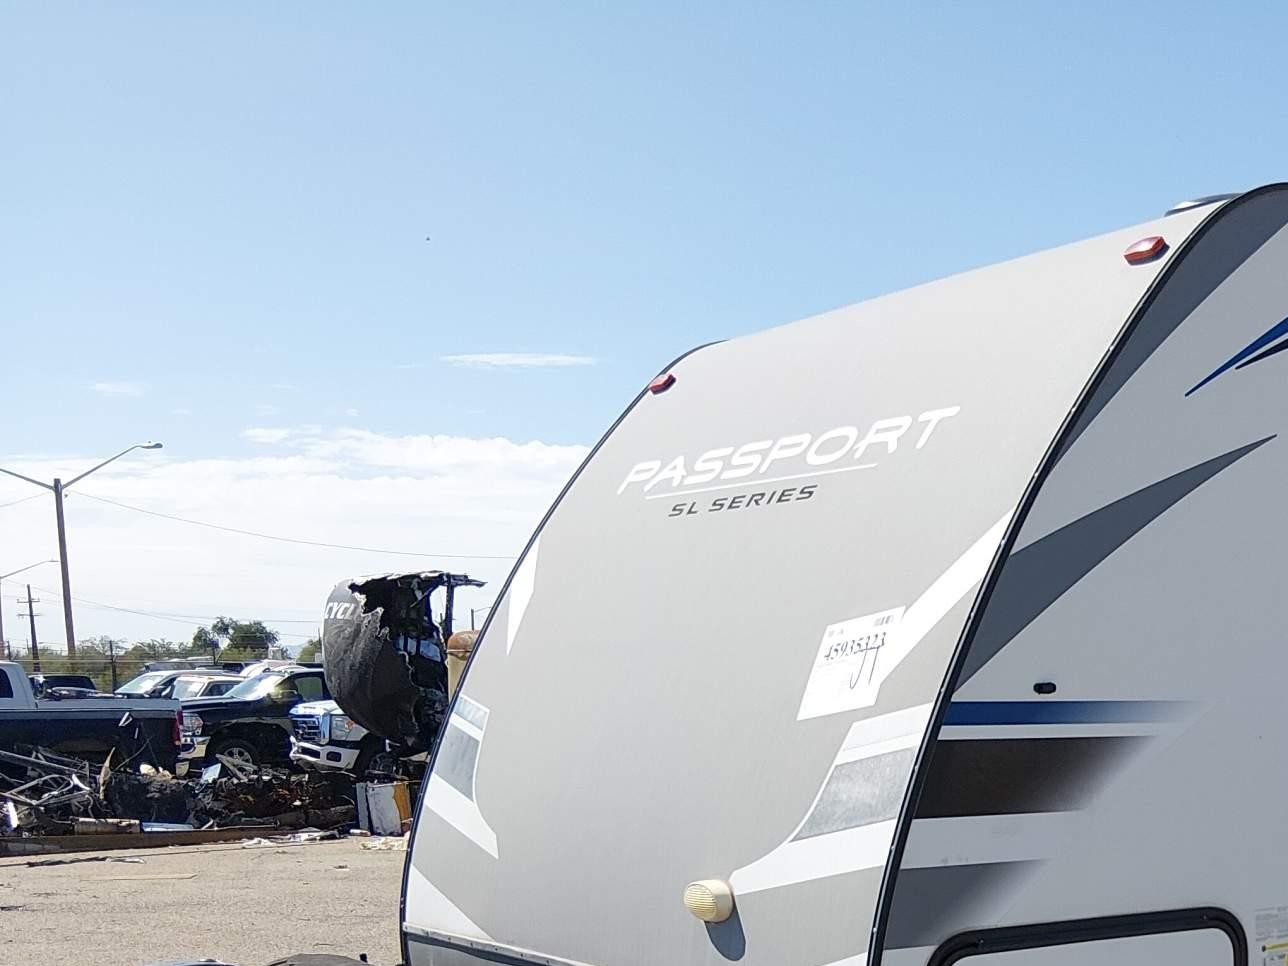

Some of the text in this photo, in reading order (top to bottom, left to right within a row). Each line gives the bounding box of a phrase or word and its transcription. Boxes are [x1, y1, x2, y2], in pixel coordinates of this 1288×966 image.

[617, 406, 961, 495] PASSPORT
[668, 484, 817, 517] SL SERIES
[324, 602, 354, 620] CYCL
